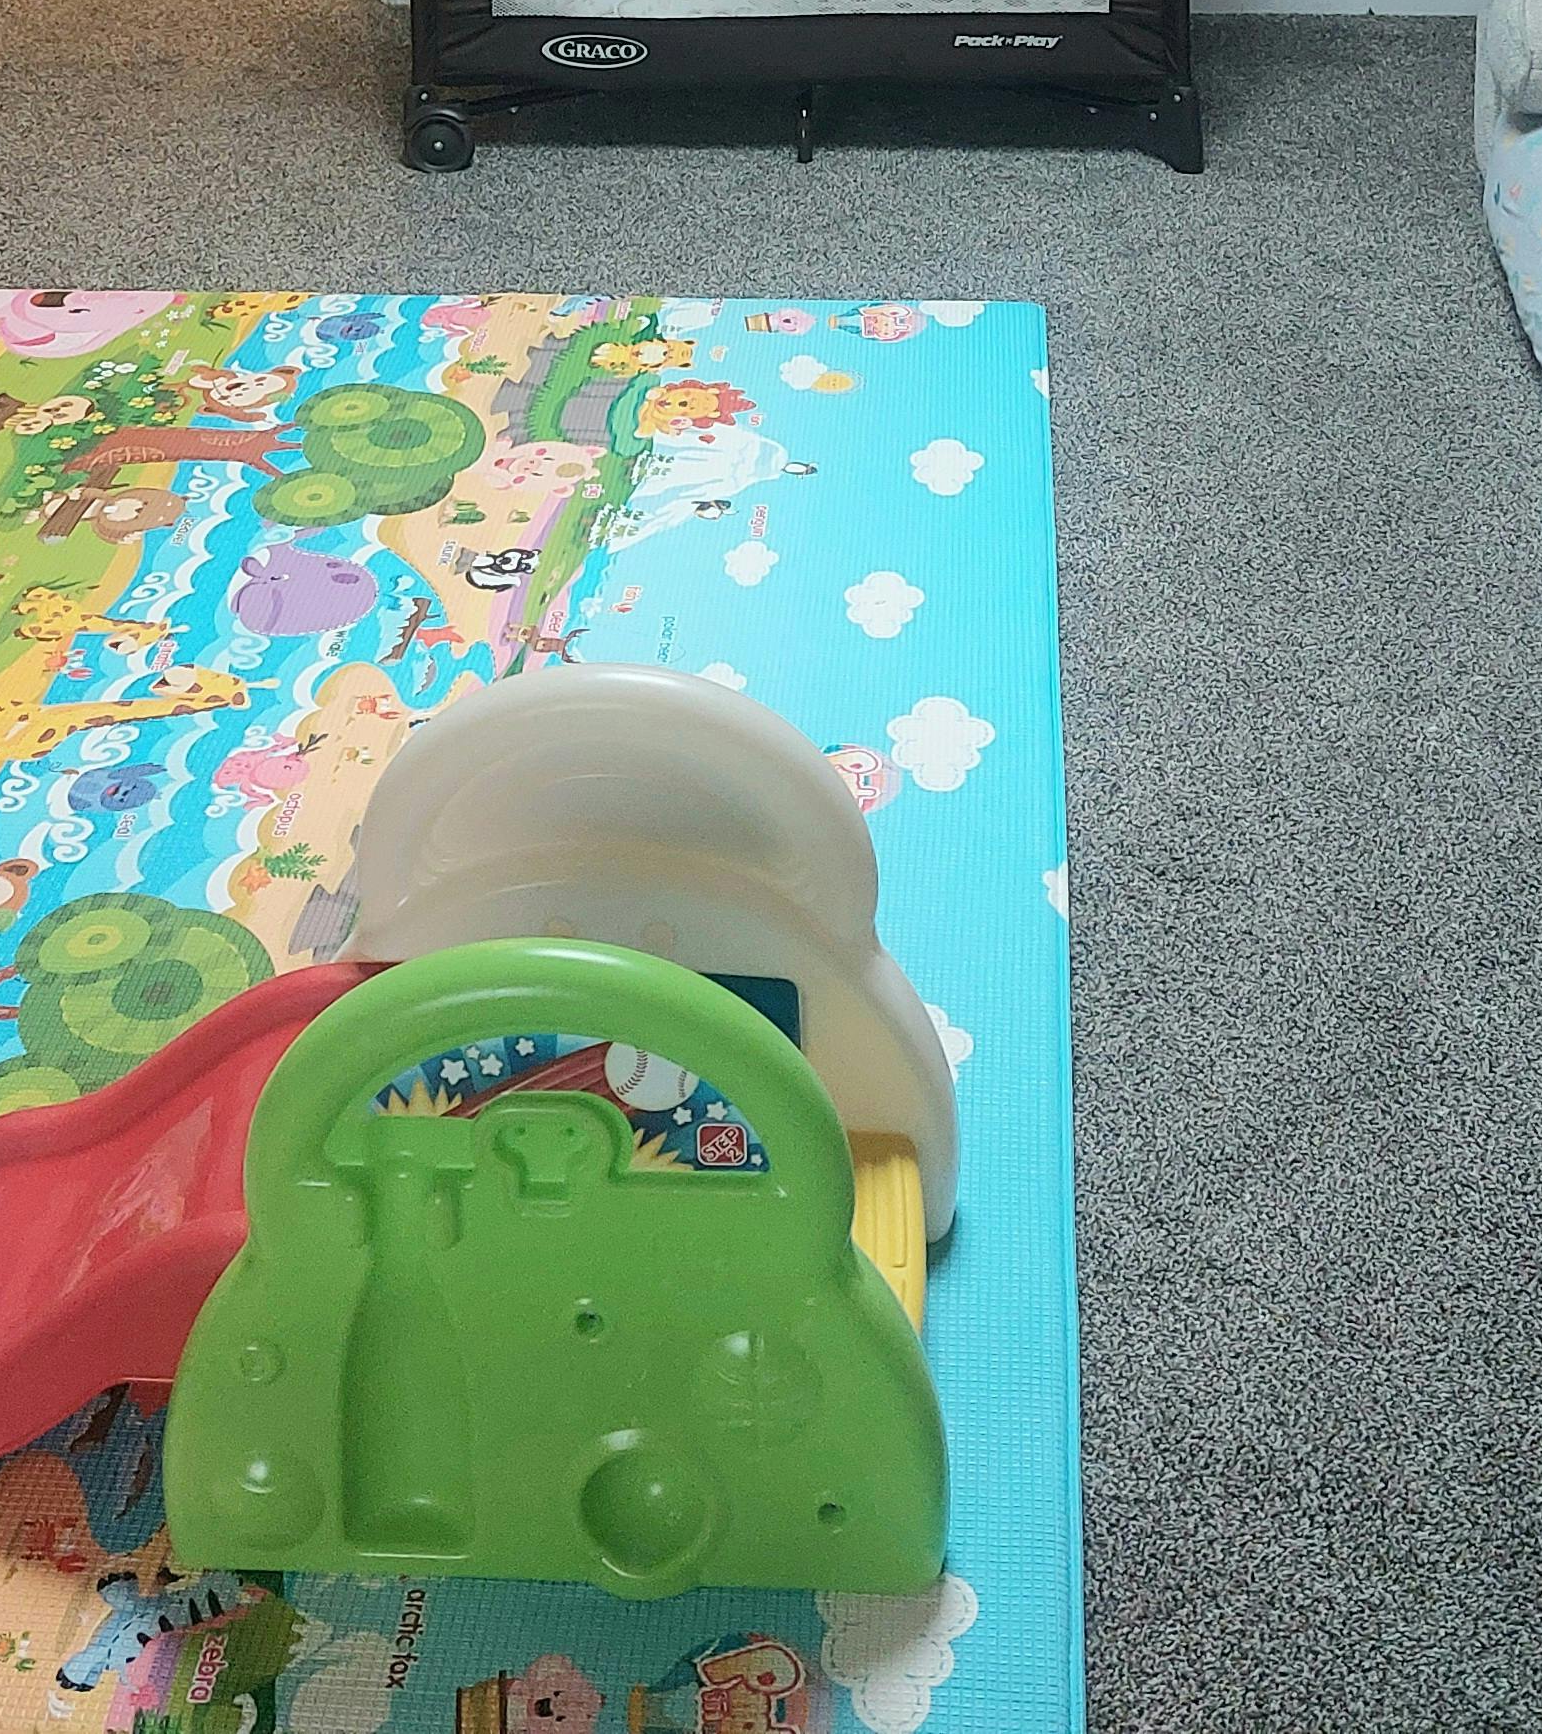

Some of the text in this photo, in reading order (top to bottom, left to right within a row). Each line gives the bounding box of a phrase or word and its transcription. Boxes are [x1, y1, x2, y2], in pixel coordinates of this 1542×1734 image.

[557, 40, 638, 59] GRACO
[954, 35, 1005, 47] Pack
[115, 813, 136, 838] seal
[274, 793, 302, 837] octopus
[702, 1127, 743, 1162] STEP 2
[385, 1589, 426, 1689] arctic fox
[191, 1635, 228, 1701] zebra
